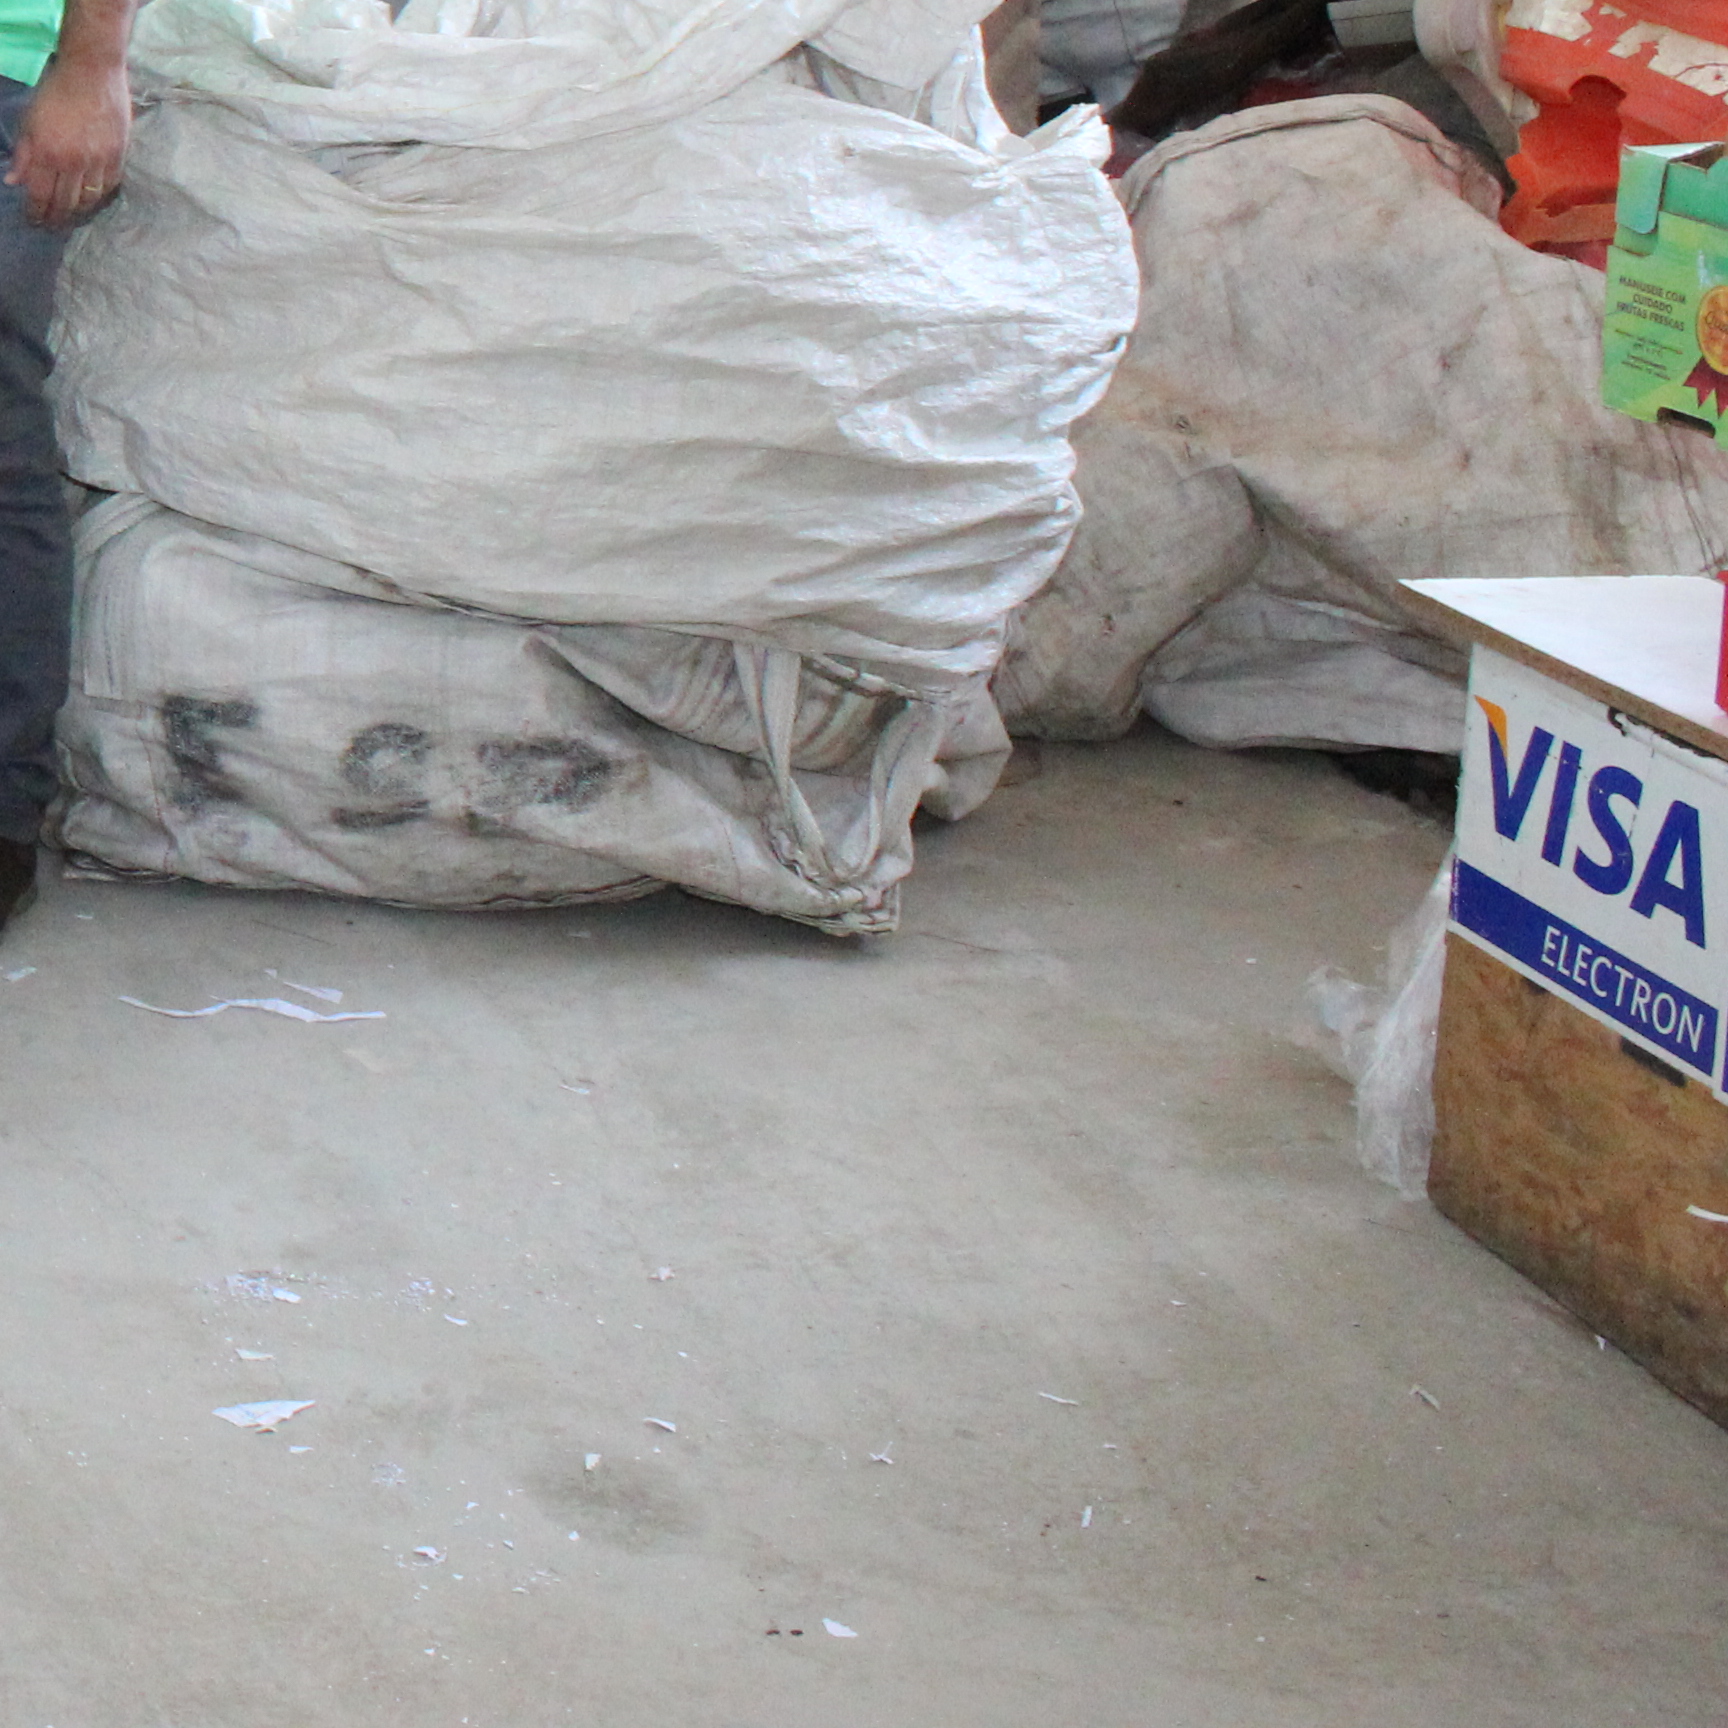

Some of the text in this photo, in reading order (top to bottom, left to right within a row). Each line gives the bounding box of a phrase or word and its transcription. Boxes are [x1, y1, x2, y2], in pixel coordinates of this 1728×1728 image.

[1632, 293, 1673, 314] CUIDADO
[1665, 290, 1686, 304] COM
[1474, 695, 1706, 950] VISA
[1541, 925, 1707, 1055] ELECTRON
